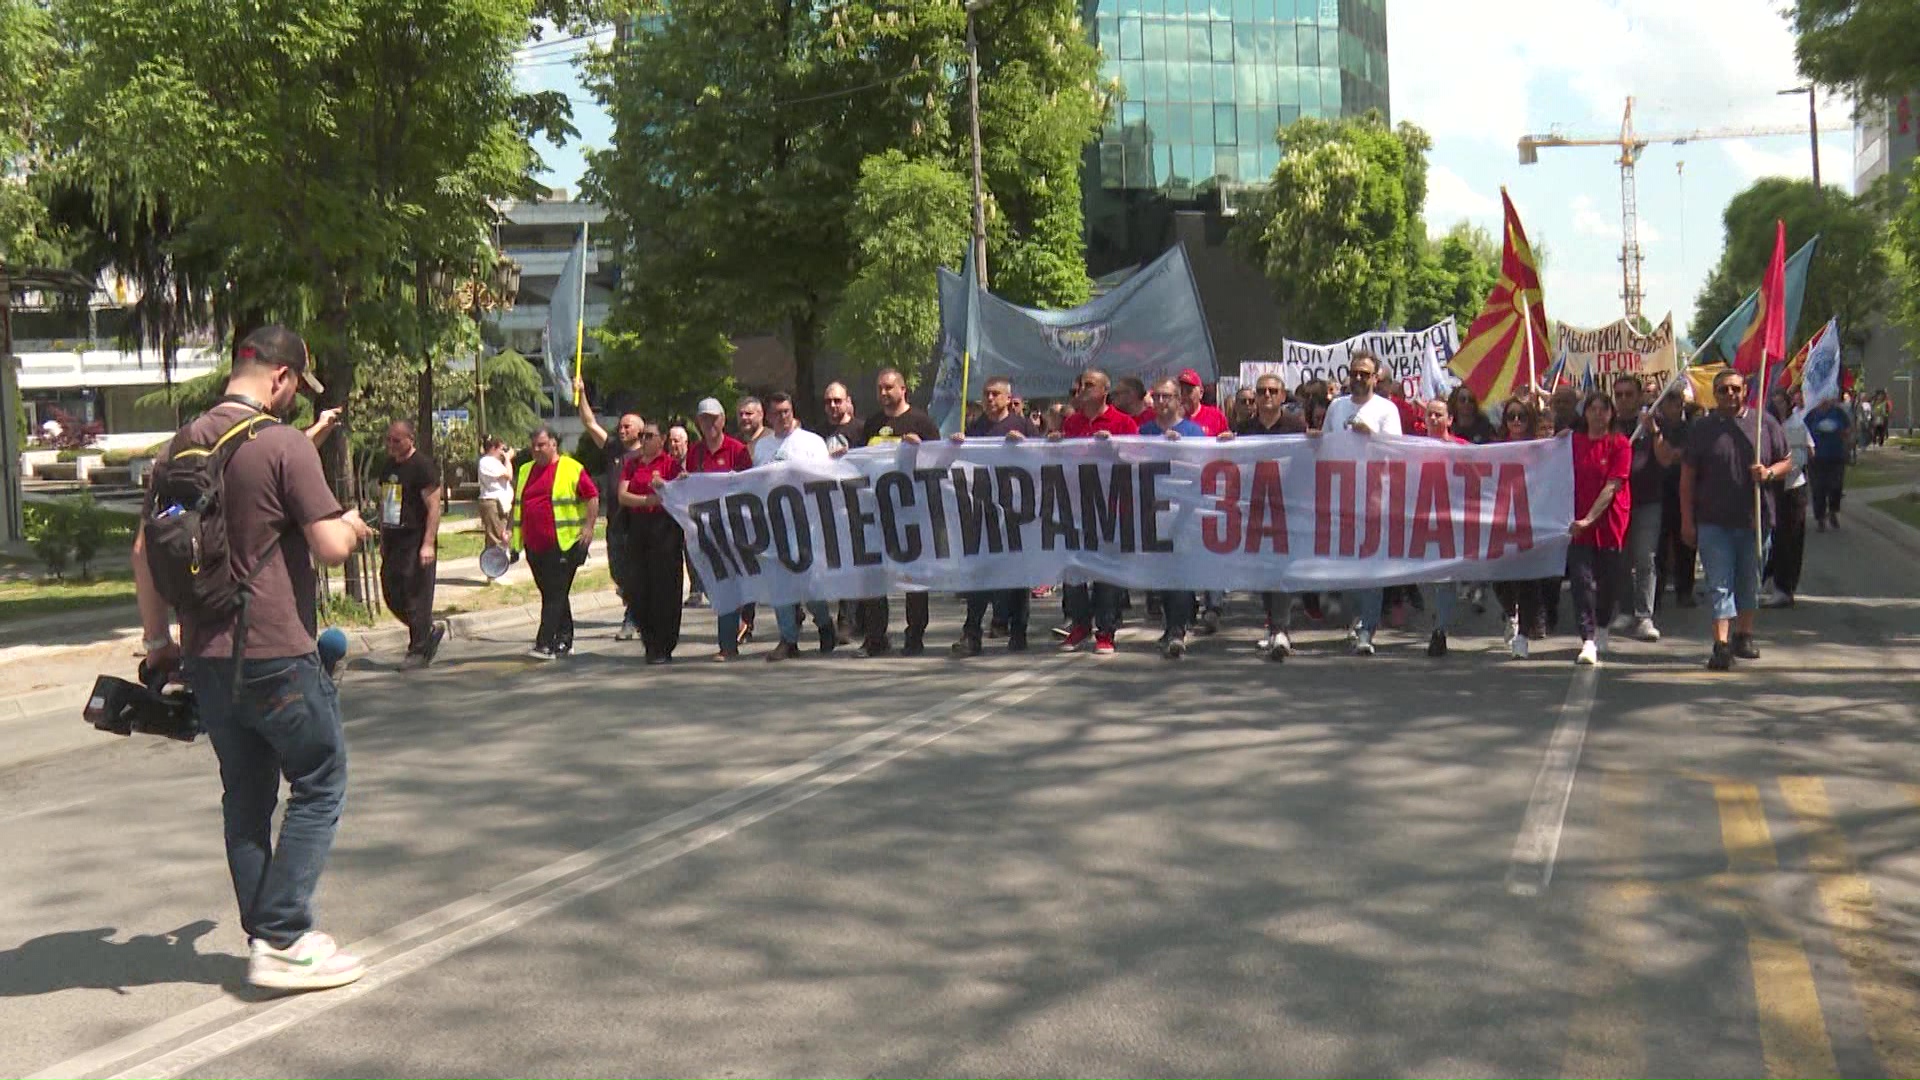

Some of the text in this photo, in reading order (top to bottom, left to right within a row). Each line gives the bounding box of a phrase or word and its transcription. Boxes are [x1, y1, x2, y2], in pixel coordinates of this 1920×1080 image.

[1286, 343, 1335, 365] ДОЛУ
[689, 459, 1534, 581] ПРОТЕСТИРАМЕ ЗА ПЛАТА
